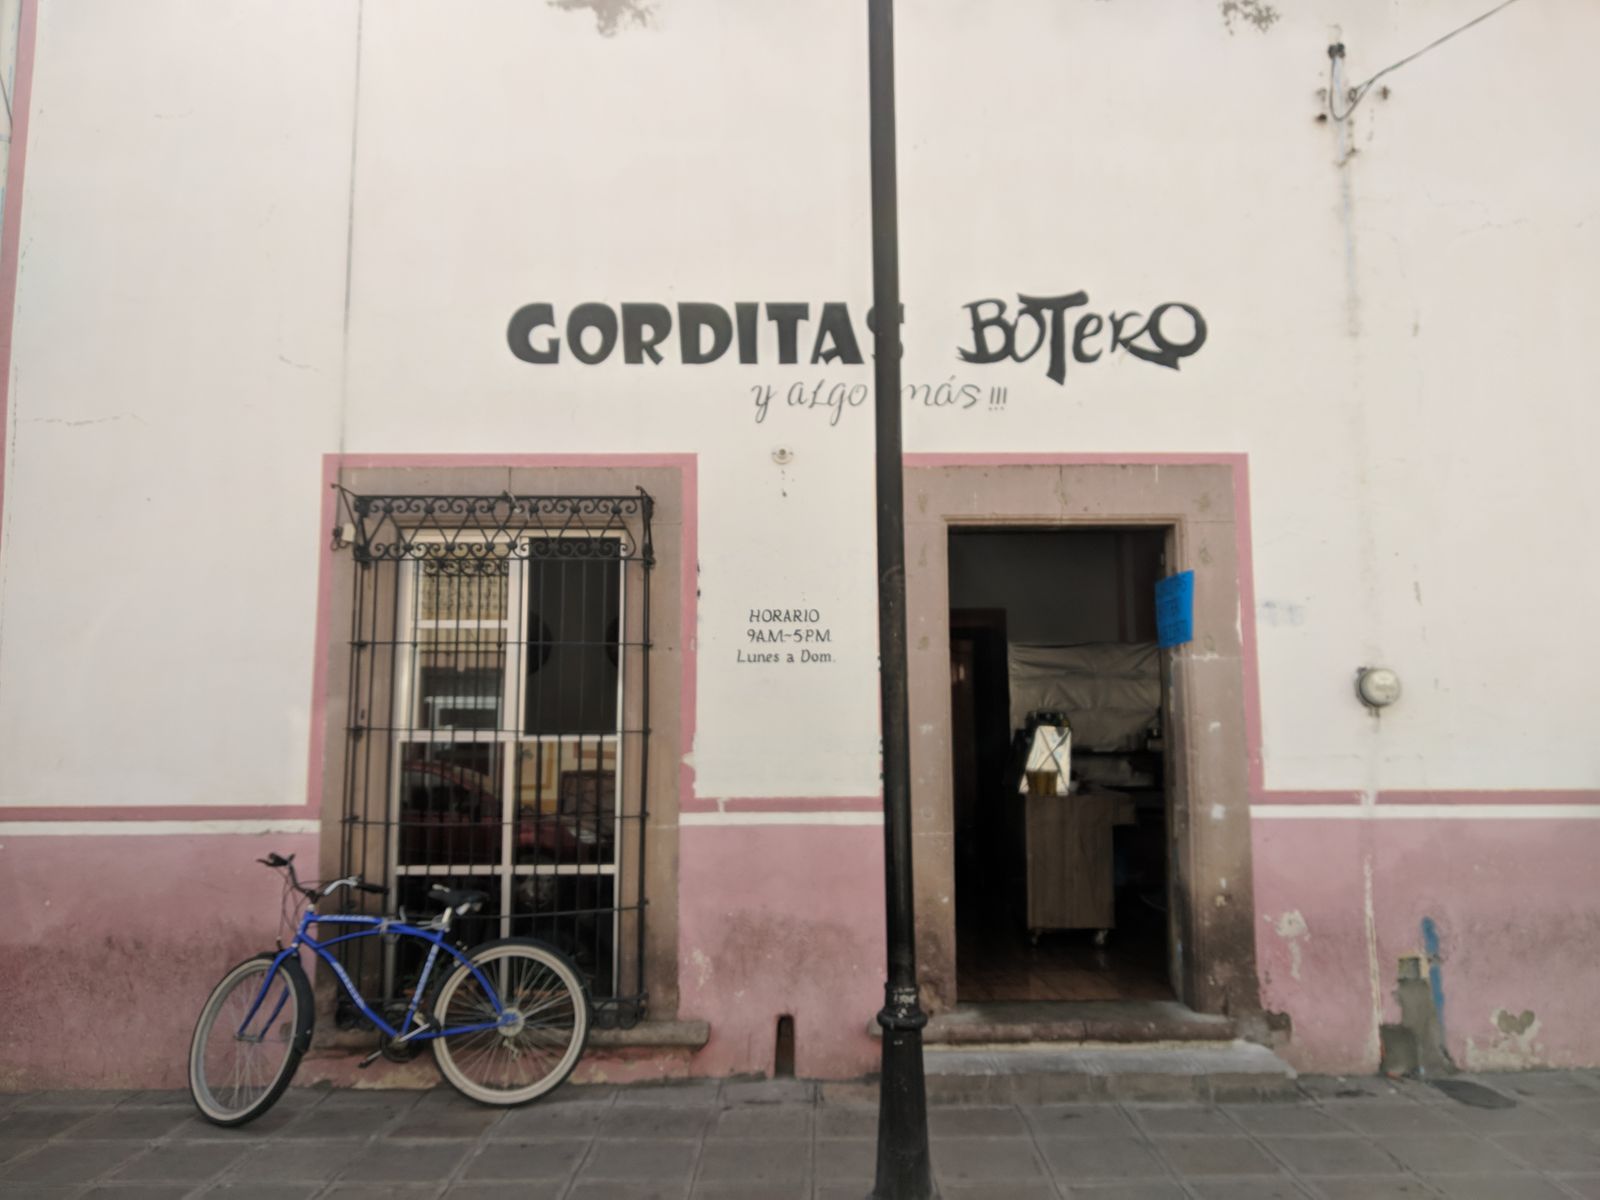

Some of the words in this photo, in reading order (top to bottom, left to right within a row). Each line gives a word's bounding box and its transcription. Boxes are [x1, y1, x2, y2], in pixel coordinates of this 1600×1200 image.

[751, 384, 777, 424] y
[748, 608, 820, 623] HORARIO
[737, 648, 780, 663] Lunes
[786, 652, 795, 663] a
[800, 648, 836, 663] Dom.
